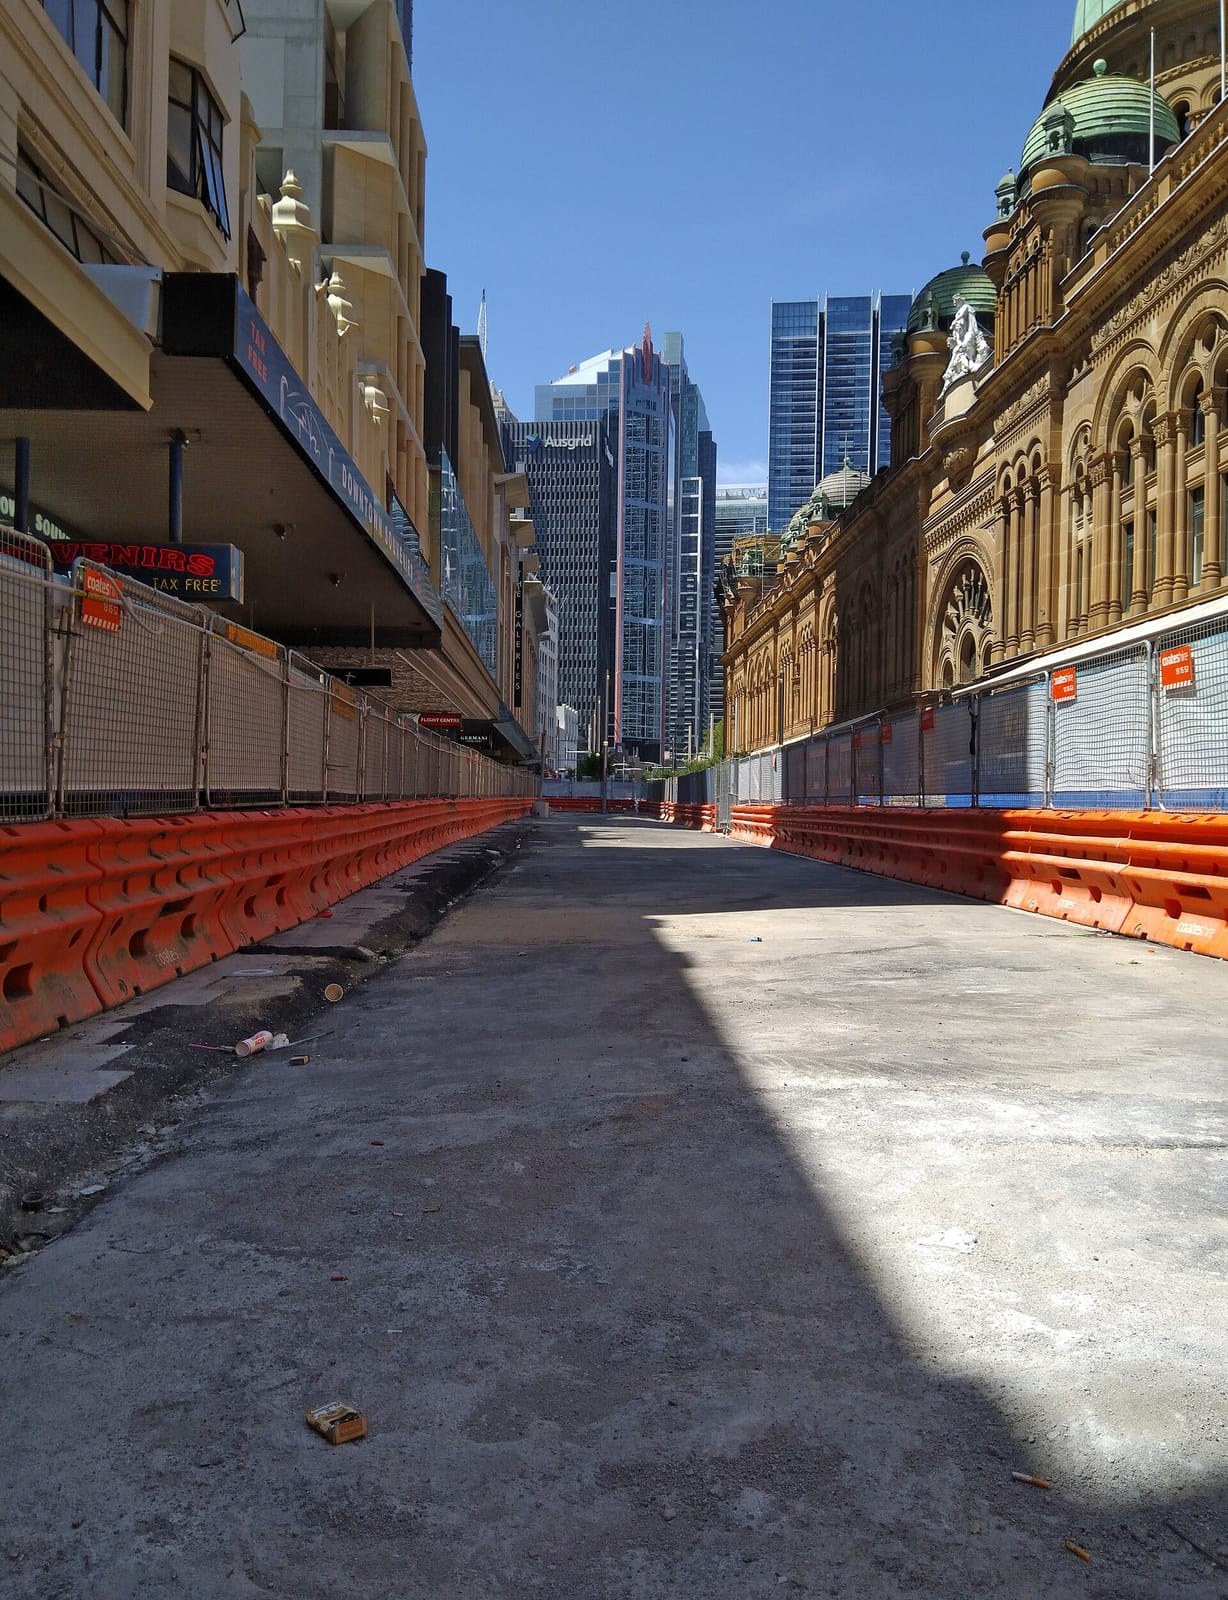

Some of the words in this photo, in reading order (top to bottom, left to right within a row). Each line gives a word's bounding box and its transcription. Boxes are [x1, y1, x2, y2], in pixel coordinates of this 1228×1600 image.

[250, 320, 266, 355] TAX
[248, 344, 268, 384] FREE
[544, 434, 592, 450] Ausgrid
[342, 463, 383, 538] DOWNTOWN
[152, 577, 179, 591] TAX
[185, 578, 219, 592] FREE
